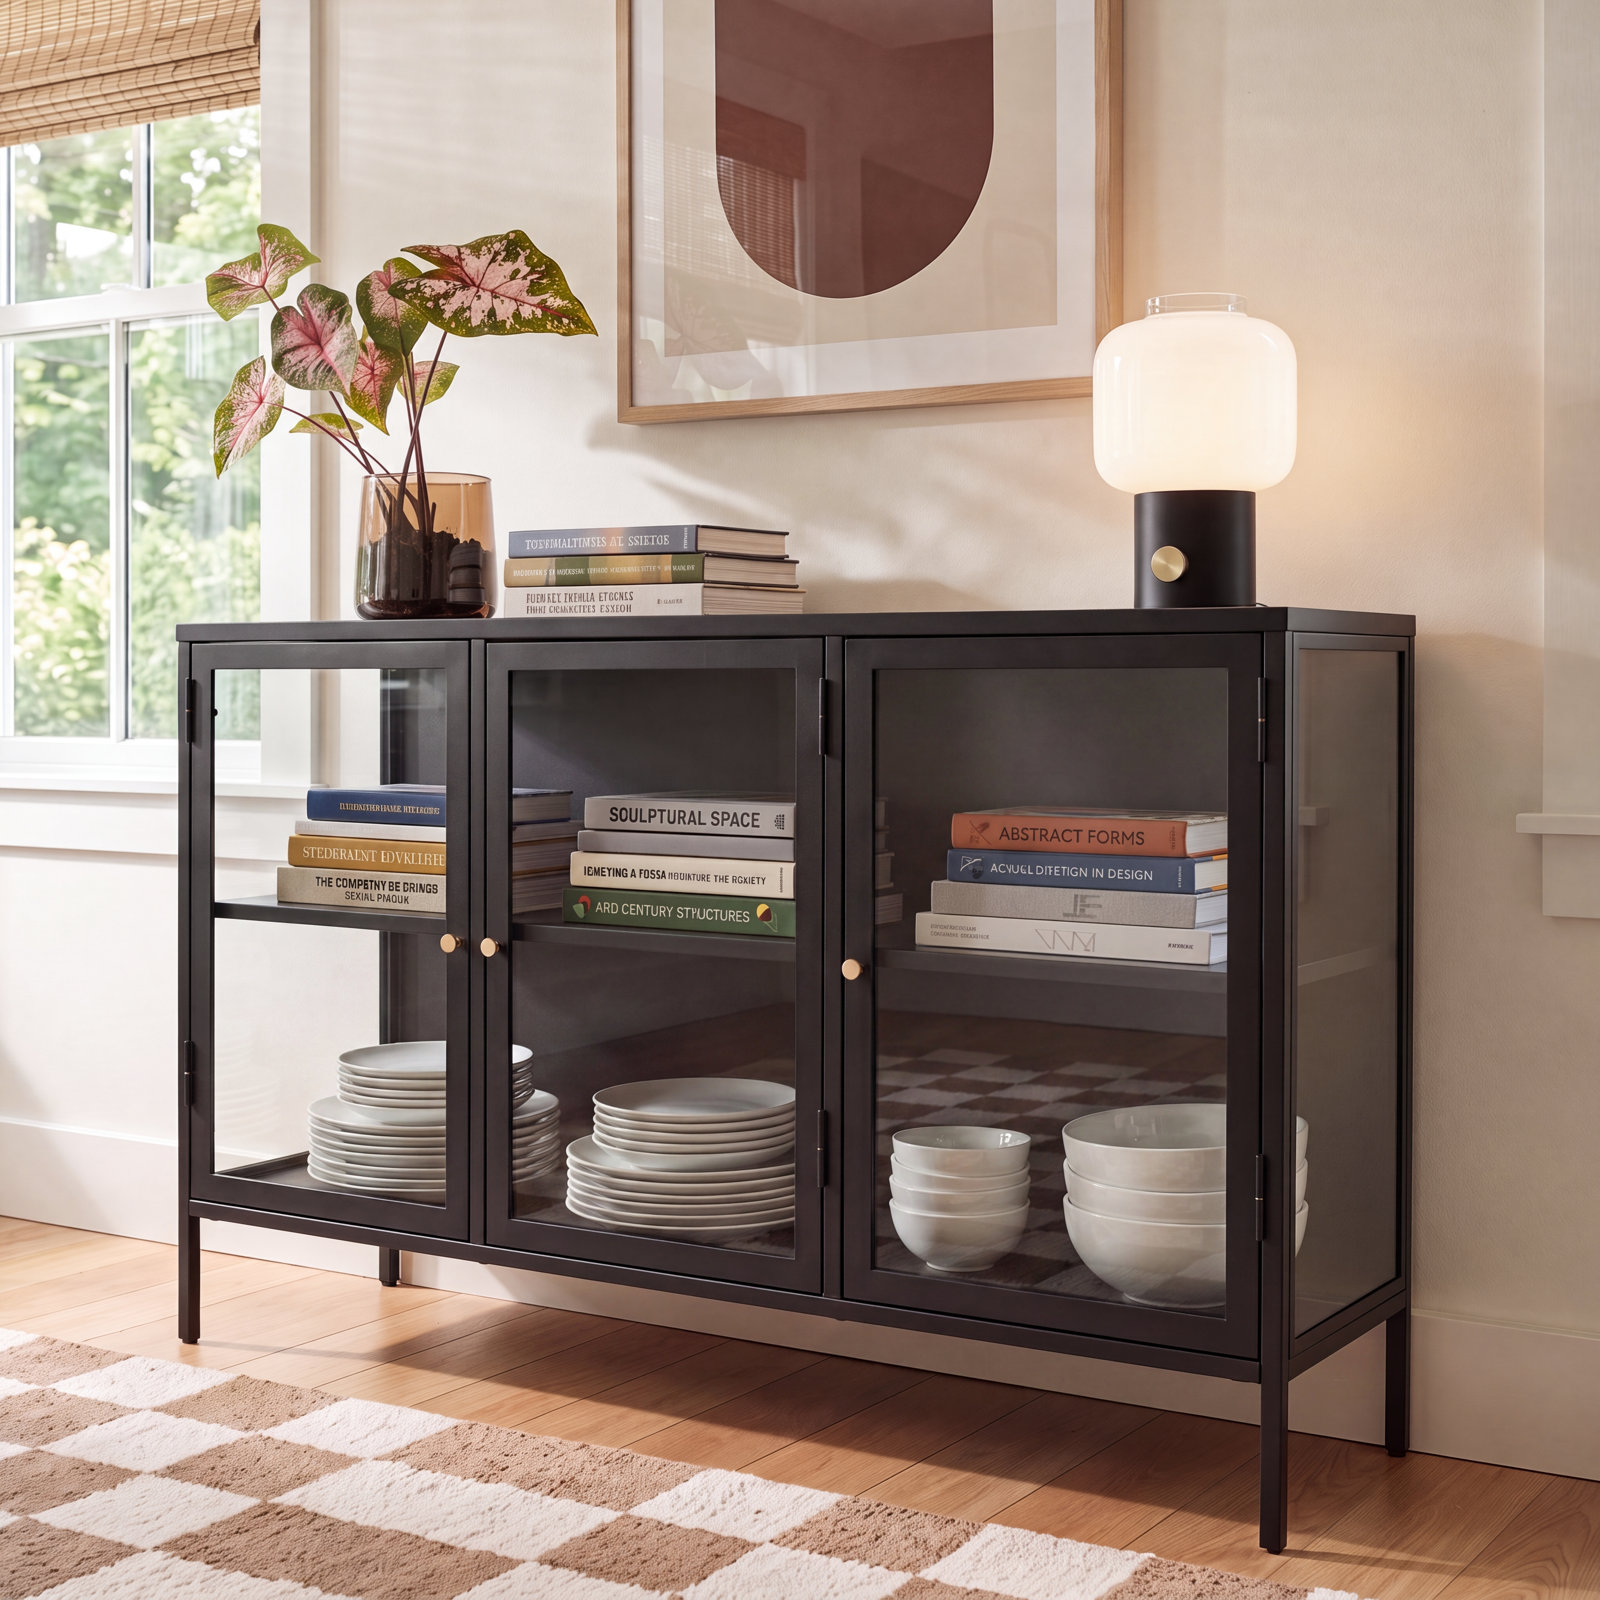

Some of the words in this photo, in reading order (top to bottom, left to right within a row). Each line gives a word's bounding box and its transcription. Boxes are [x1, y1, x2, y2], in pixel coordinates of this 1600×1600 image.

[710, 810, 761, 829] SPACE
[998, 826, 1084, 844] ABSTRACT
[1087, 829, 1145, 846] FORMS
[630, 868, 637, 879] A
[639, 868, 667, 880] FOSSA
[714, 874, 730, 884] THE
[1092, 867, 1104, 879] IN
[1107, 868, 1154, 882] DESIGN
[315, 876, 333, 888] THE
[388, 881, 401, 892] BE
[595, 901, 619, 915] ARD
[621, 903, 674, 919] CENTURY
